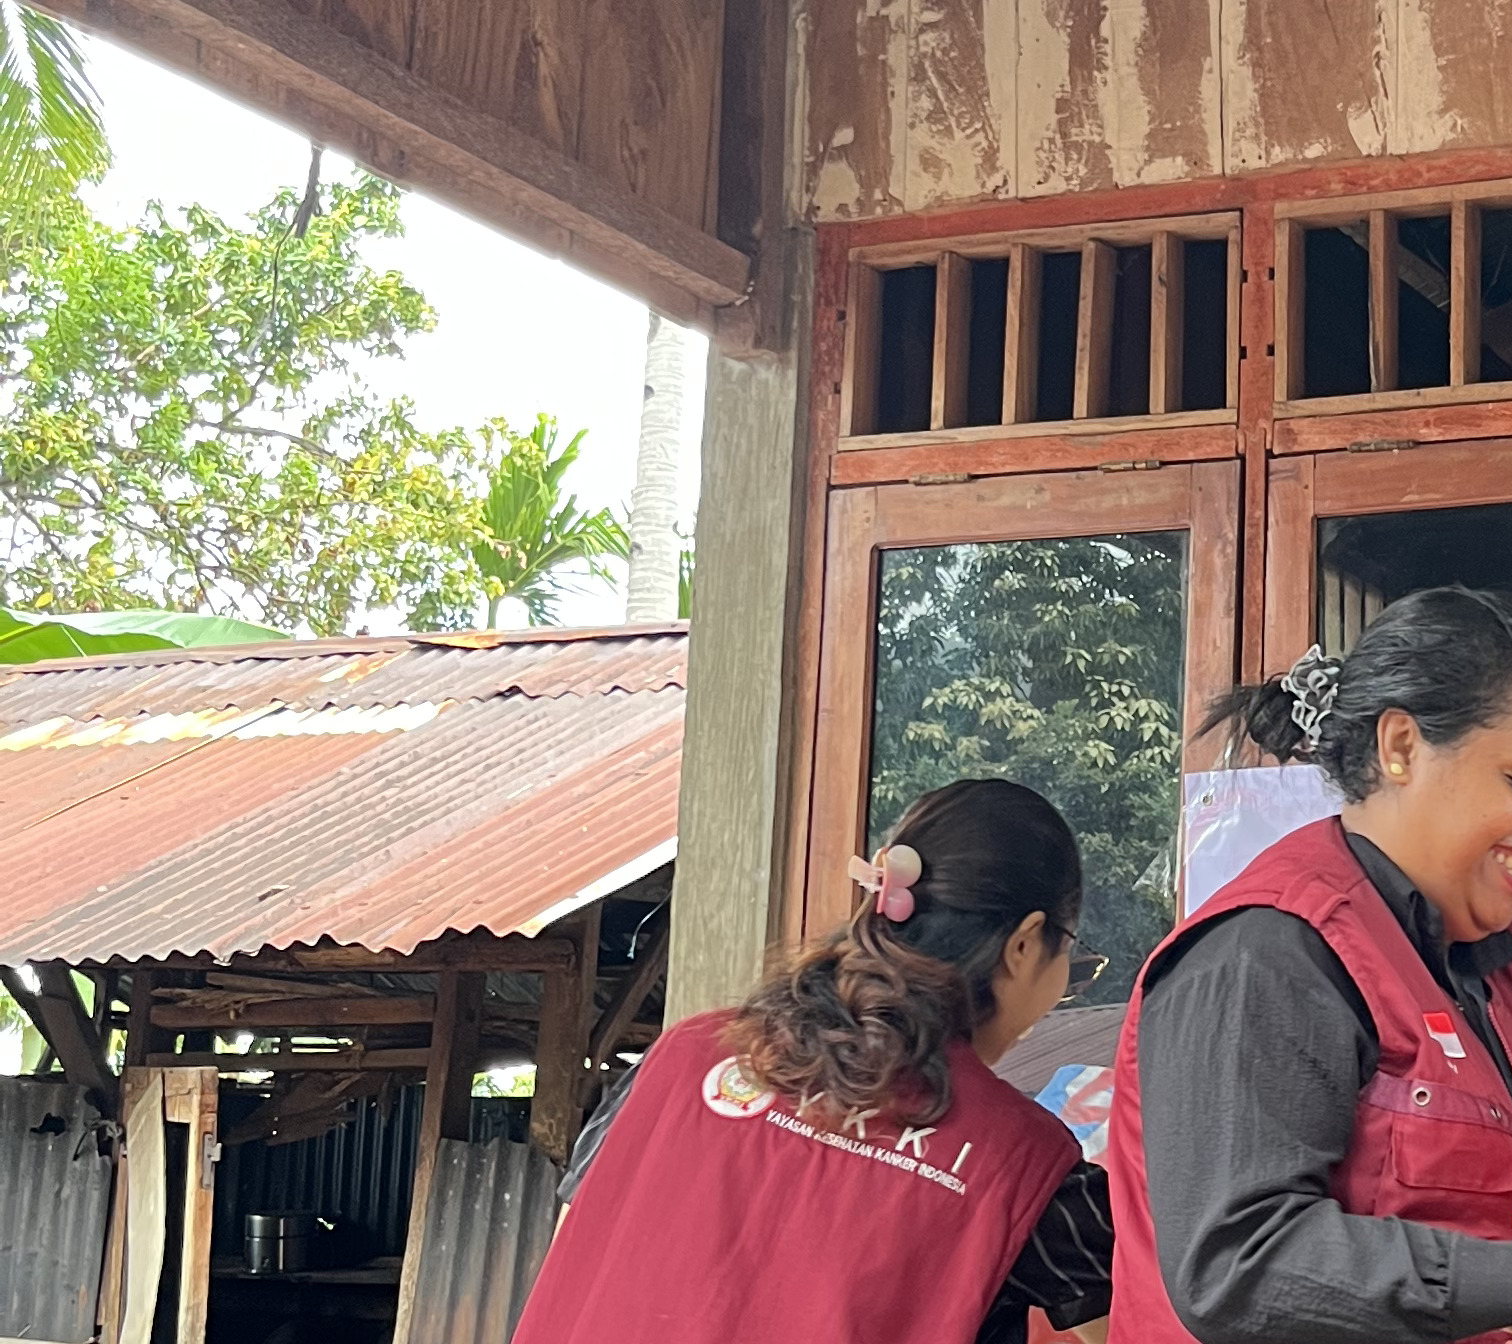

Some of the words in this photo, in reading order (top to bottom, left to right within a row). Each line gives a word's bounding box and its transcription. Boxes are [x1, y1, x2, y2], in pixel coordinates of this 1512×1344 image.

[765, 1110, 815, 1139] YAYASAN
[874, 1147, 920, 1172] KANKER
[917, 1162, 967, 1197] INDONESIA
